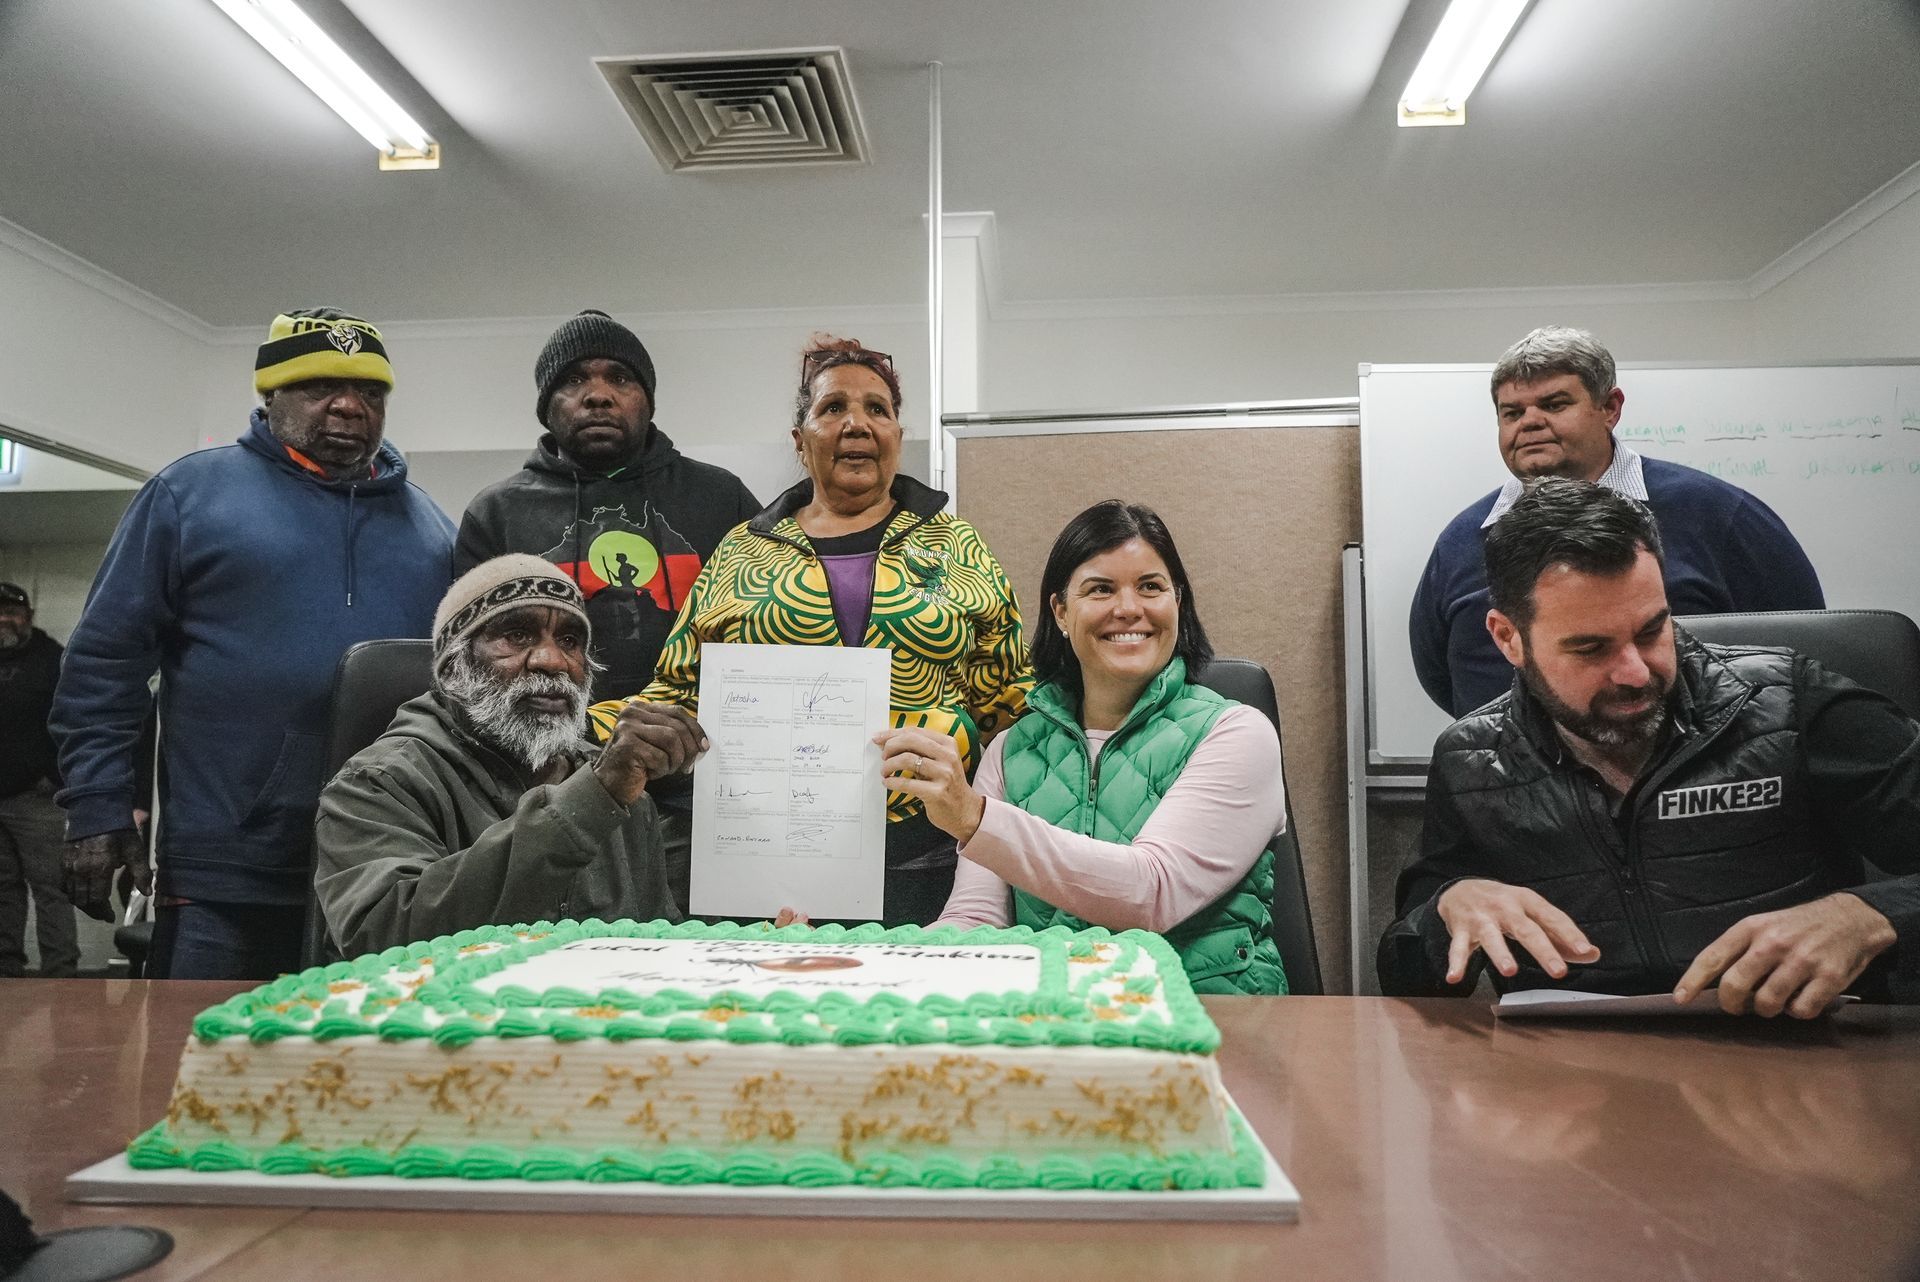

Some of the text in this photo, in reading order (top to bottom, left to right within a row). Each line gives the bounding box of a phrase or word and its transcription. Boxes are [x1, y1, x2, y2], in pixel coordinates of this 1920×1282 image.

[1661, 779, 1780, 817] FINKE22
[562, 944, 668, 952] Local
[883, 951, 1035, 960] Making
